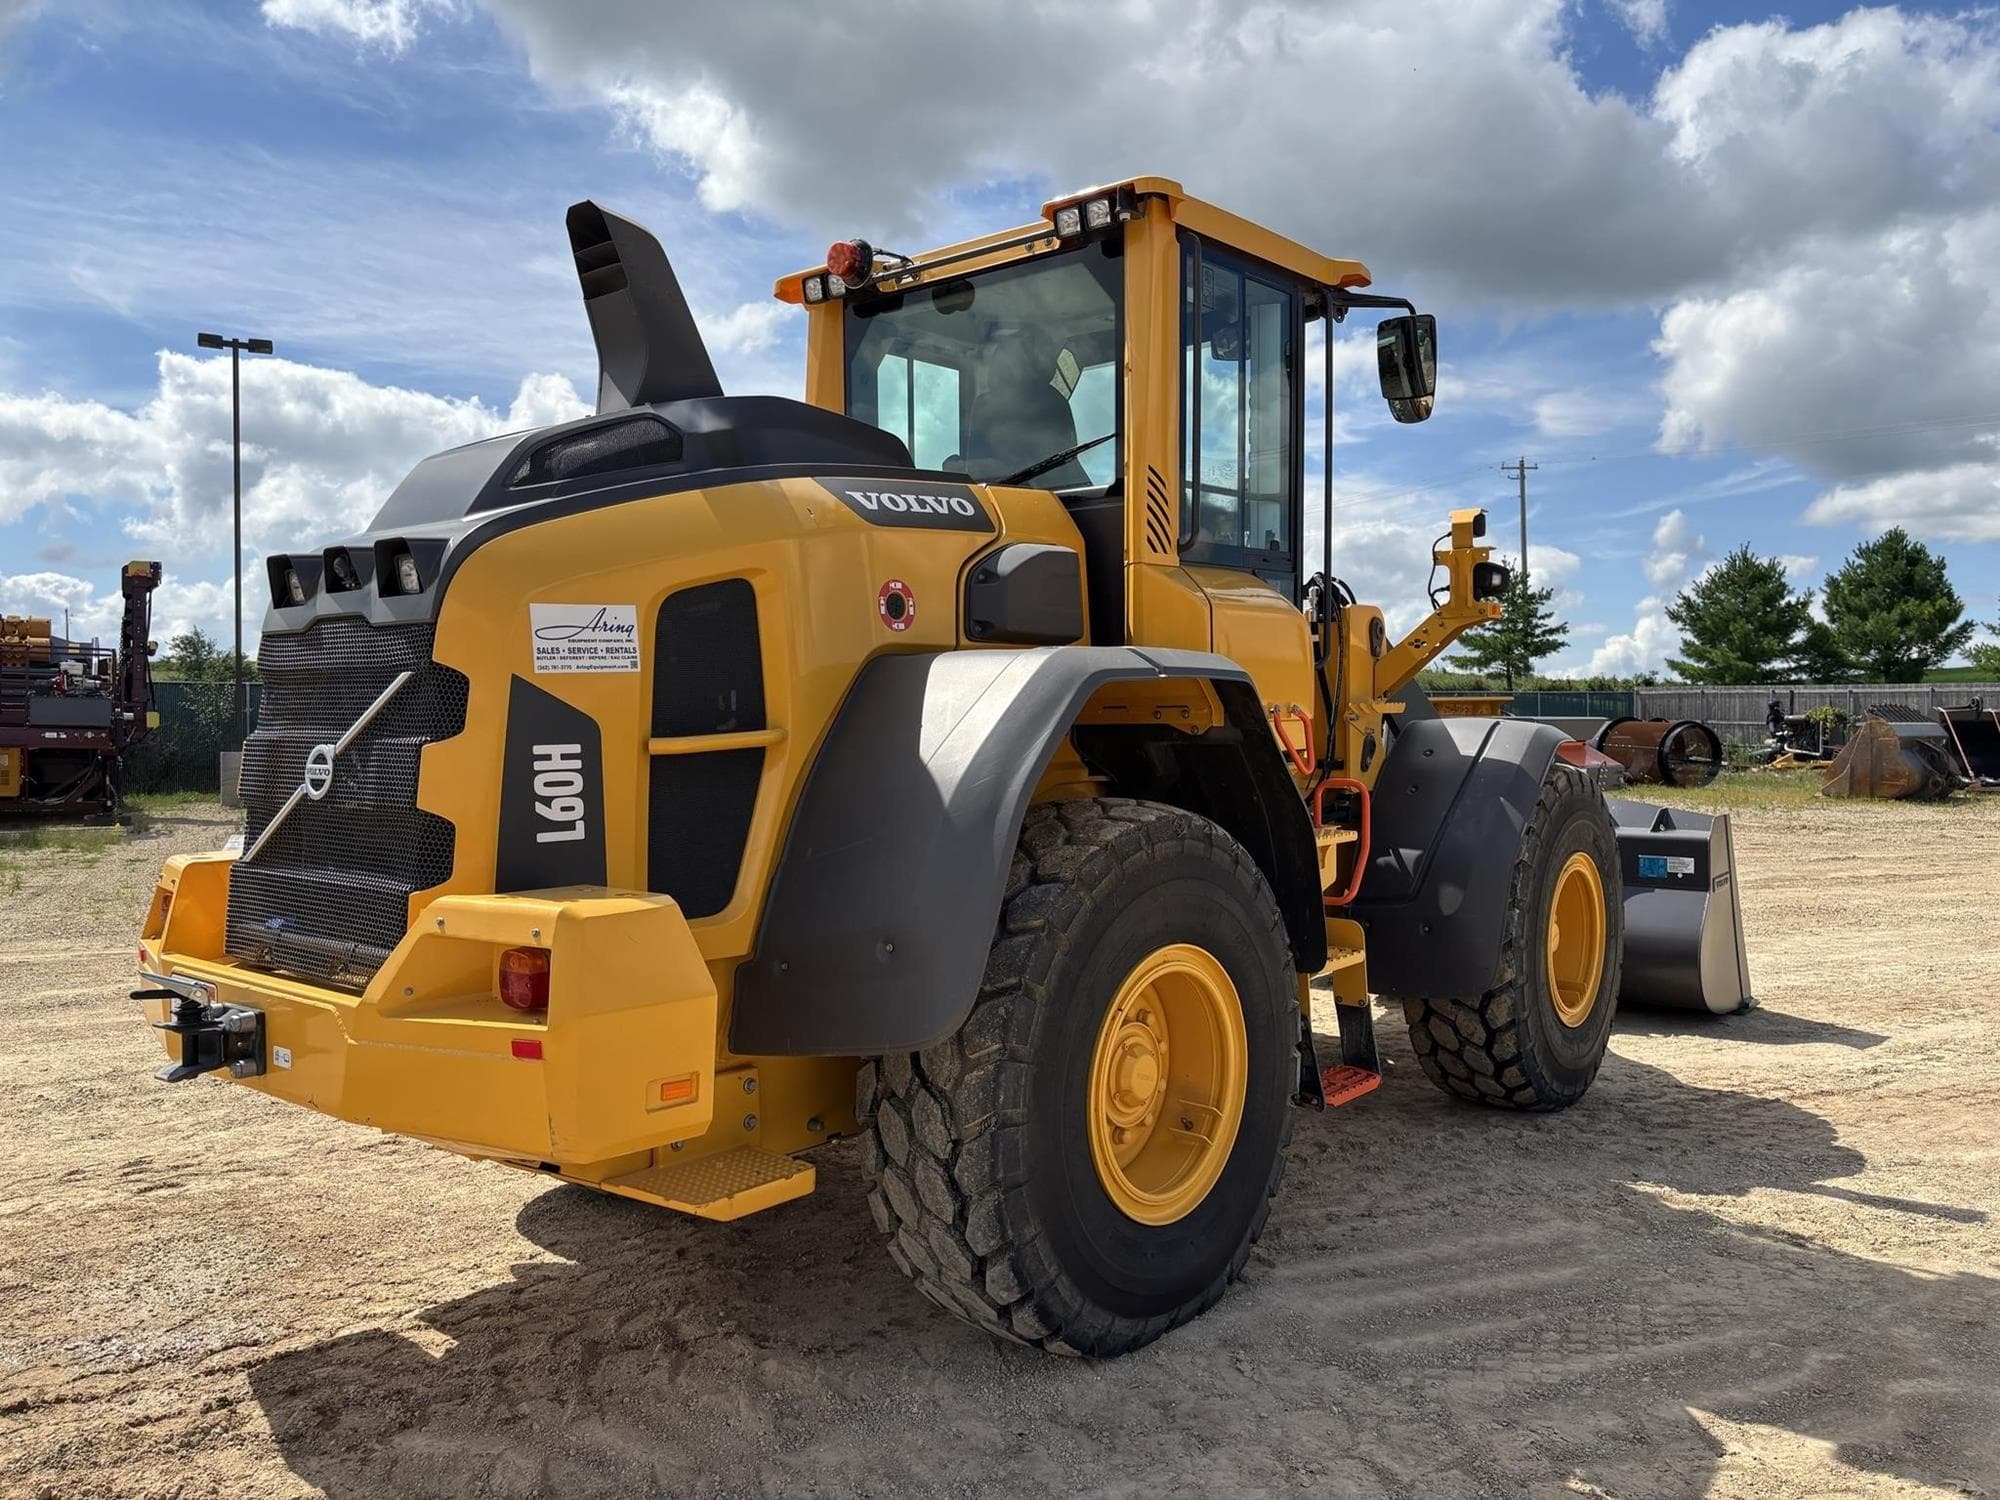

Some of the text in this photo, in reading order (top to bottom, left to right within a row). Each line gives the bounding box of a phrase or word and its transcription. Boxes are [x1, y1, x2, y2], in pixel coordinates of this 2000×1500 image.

[845, 491, 975, 517] VOLVO
[535, 607, 635, 640] Aring
[536, 646, 637, 655] SALES SERVICE RENTALS
[533, 744, 585, 843] L60H
